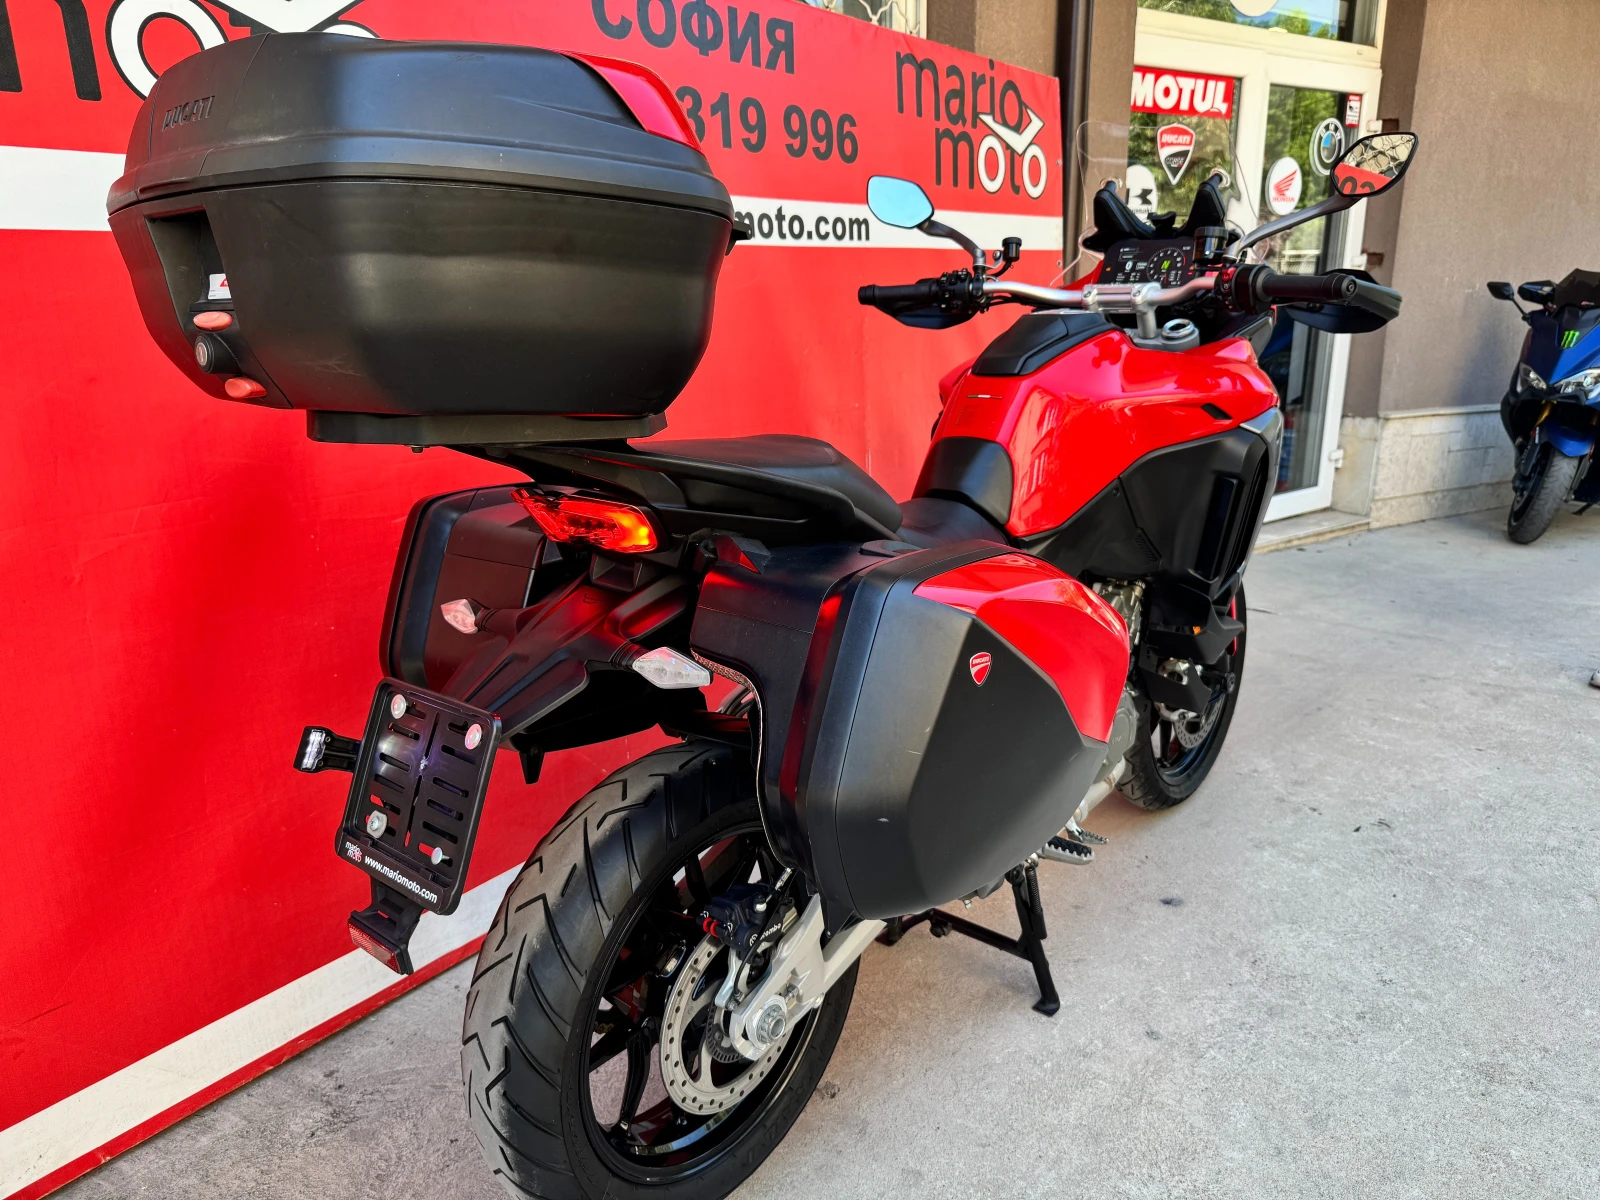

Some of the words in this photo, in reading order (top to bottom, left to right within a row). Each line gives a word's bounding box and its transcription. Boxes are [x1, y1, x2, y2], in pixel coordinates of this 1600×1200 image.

[161, 95, 216, 132] DUCATI
[895, 51, 1024, 134] mario
[1130, 71, 1229, 115] MOTUL
[782, 104, 859, 164] 996
[1161, 132, 1191, 145] DUCATI
[934, 127, 1048, 199] moto
[364, 855, 438, 904] www.mariomoto.com
